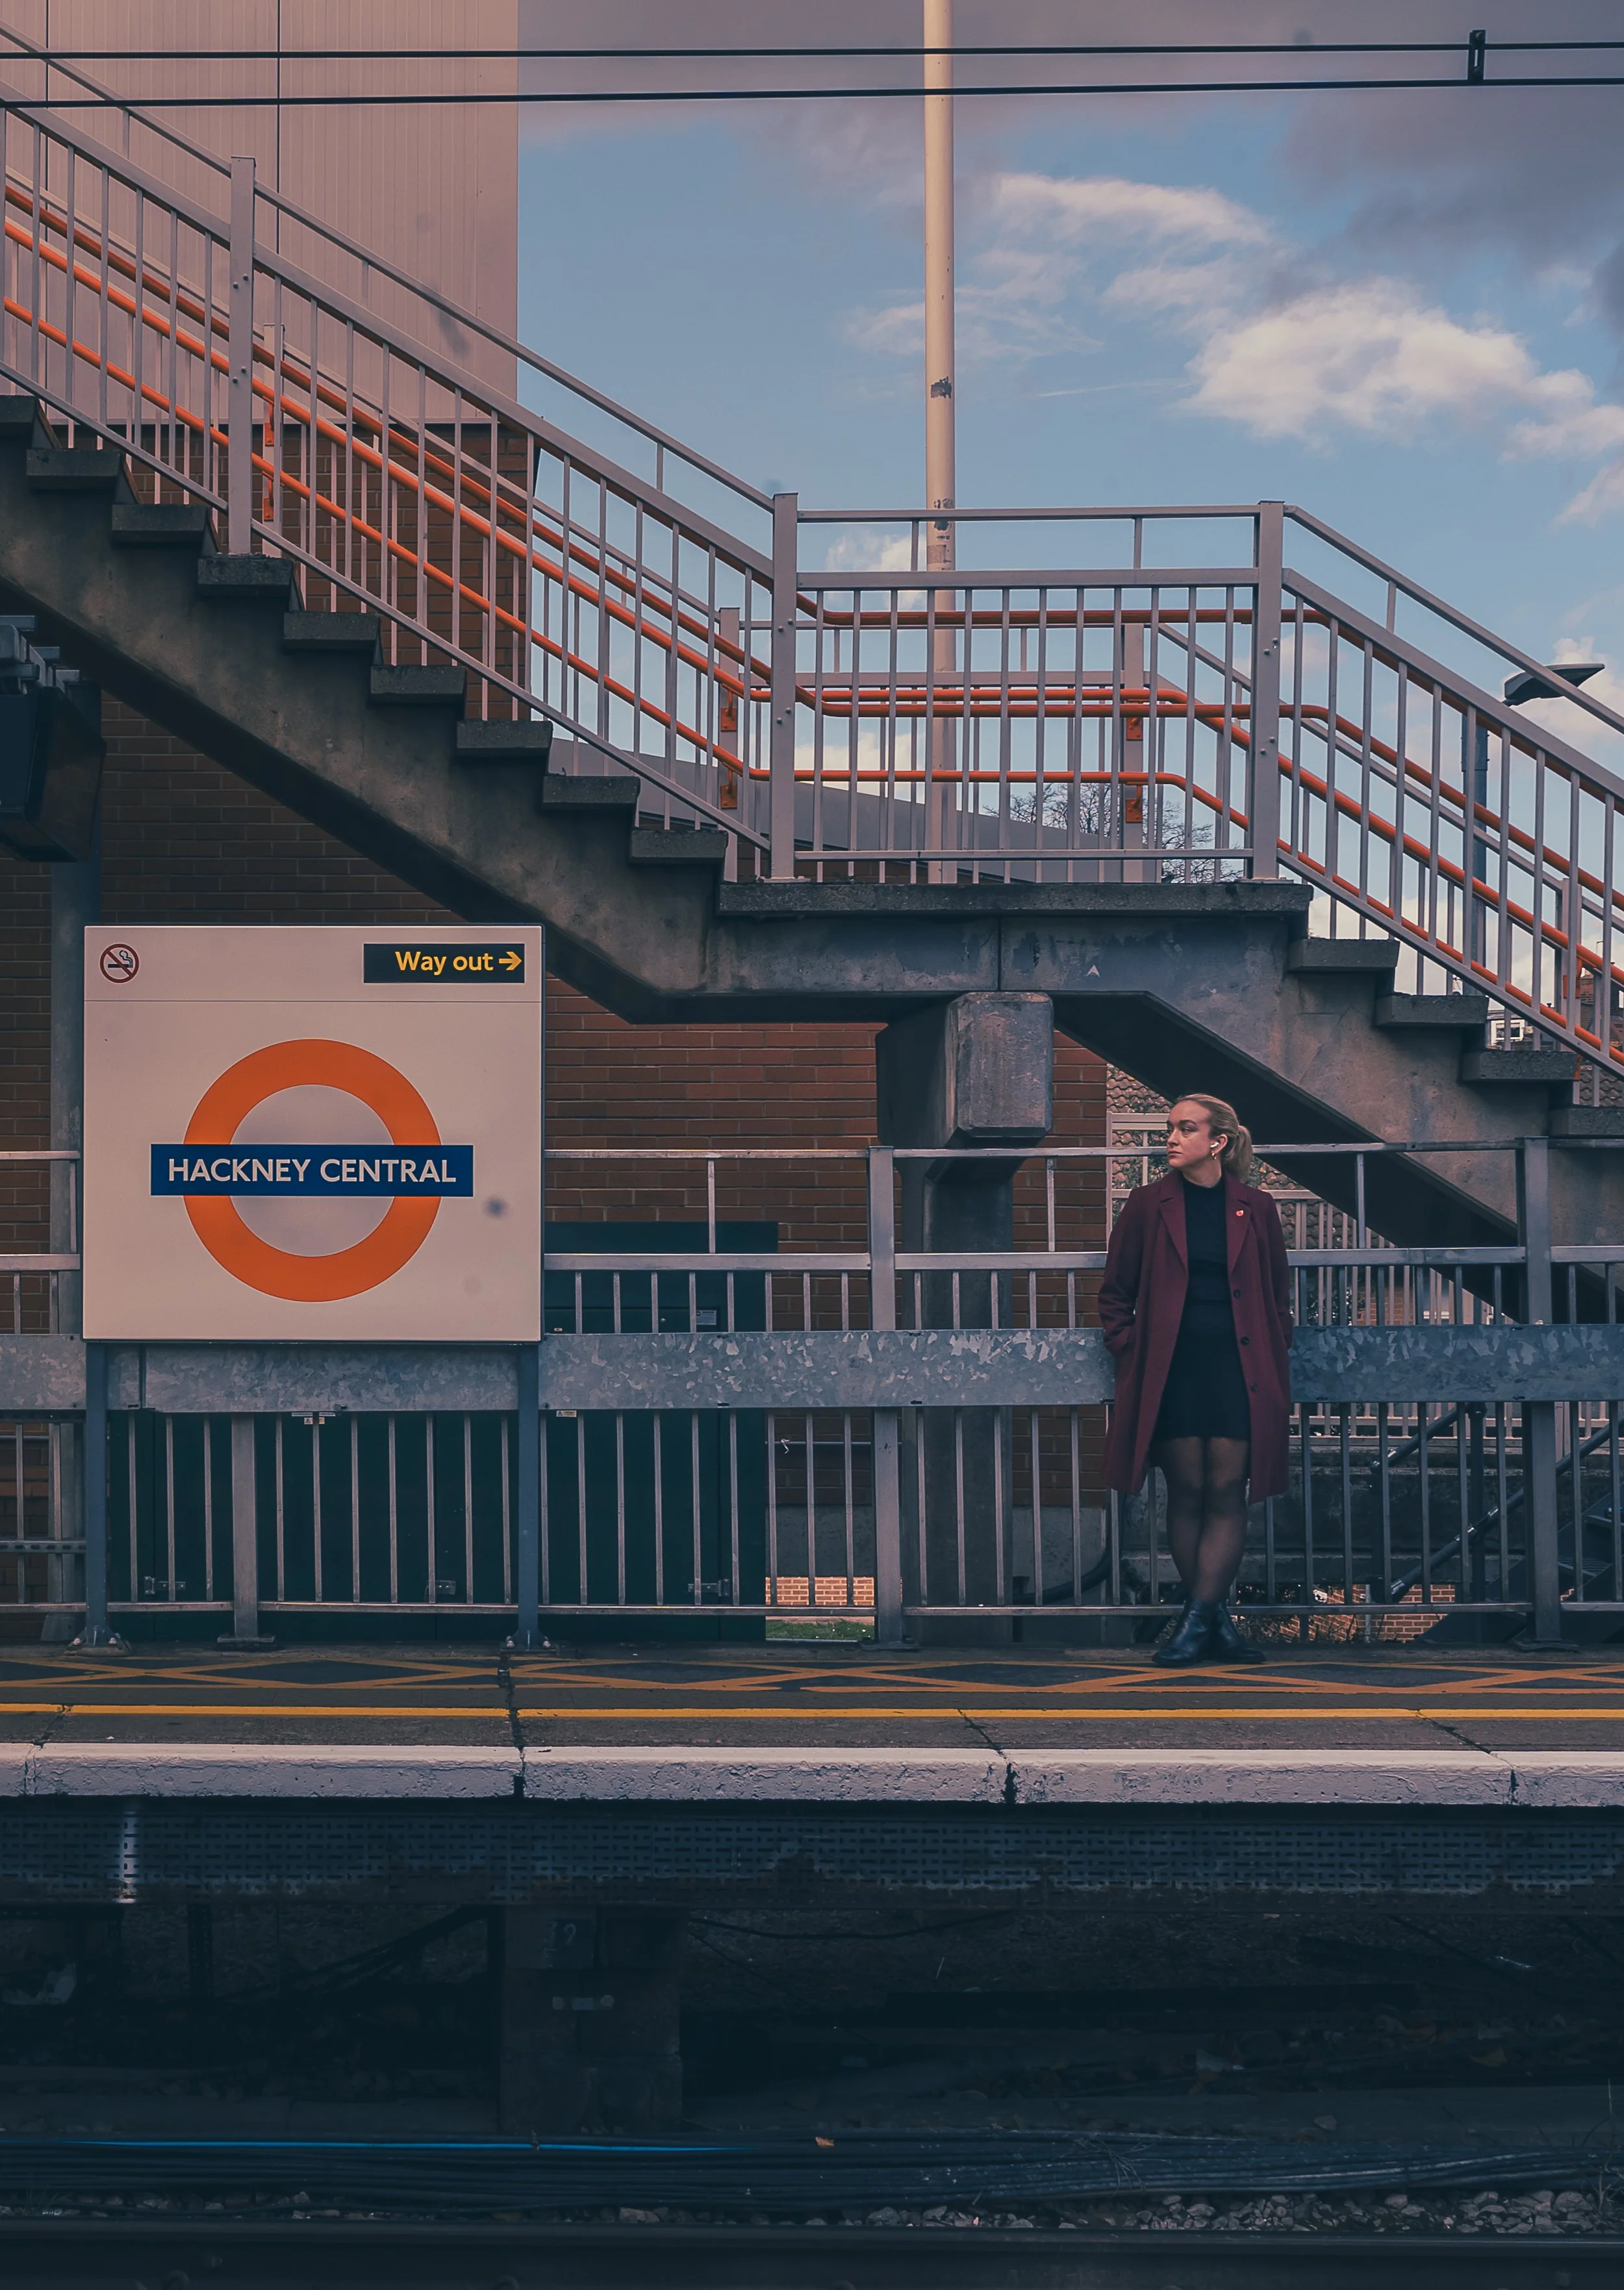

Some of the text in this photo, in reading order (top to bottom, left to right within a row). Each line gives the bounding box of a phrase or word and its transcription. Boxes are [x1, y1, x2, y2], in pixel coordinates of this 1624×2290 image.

[395, 951, 494, 976] Way out
[169, 1158, 457, 1182] HACKNEY CENTRAL
